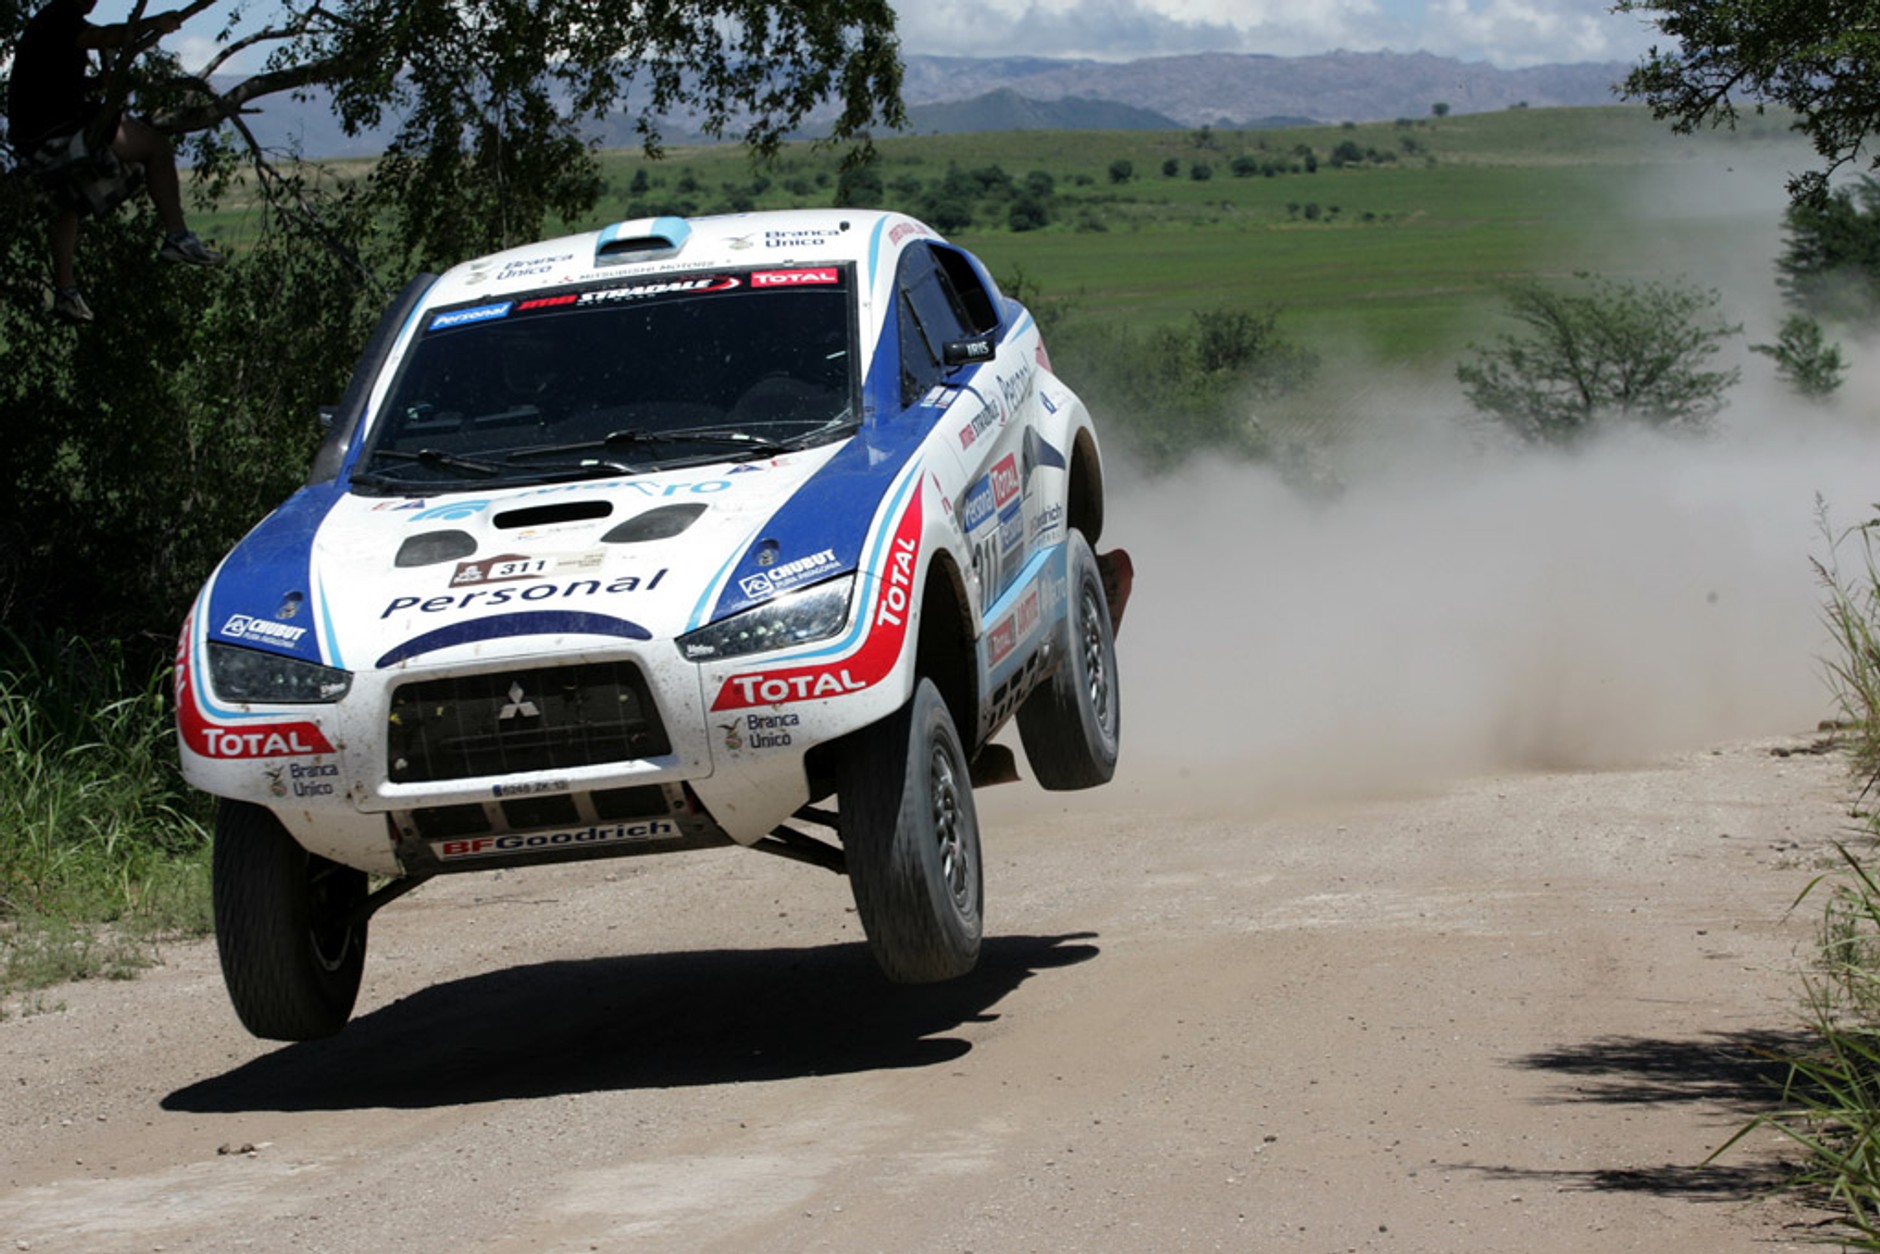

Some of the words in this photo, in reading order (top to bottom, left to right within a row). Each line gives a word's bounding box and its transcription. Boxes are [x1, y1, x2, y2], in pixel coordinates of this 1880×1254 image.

[765, 229, 840, 239] Branca
[754, 272, 835, 283] TOTAL
[578, 279, 714, 303] STRADALE
[991, 463, 1019, 499] TOTAL
[500, 561, 546, 575] 311
[768, 548, 836, 580] CHUBUT
[379, 568, 669, 619] Personal
[877, 537, 916, 627] TOTAL
[248, 619, 307, 641] CHUBUT
[733, 669, 867, 703] TOTAL
[747, 713, 800, 730] Branca
[202, 728, 313, 756] TOTAL
[290, 763, 339, 778] Branca
[443, 821, 672, 856] BFGoodrich
